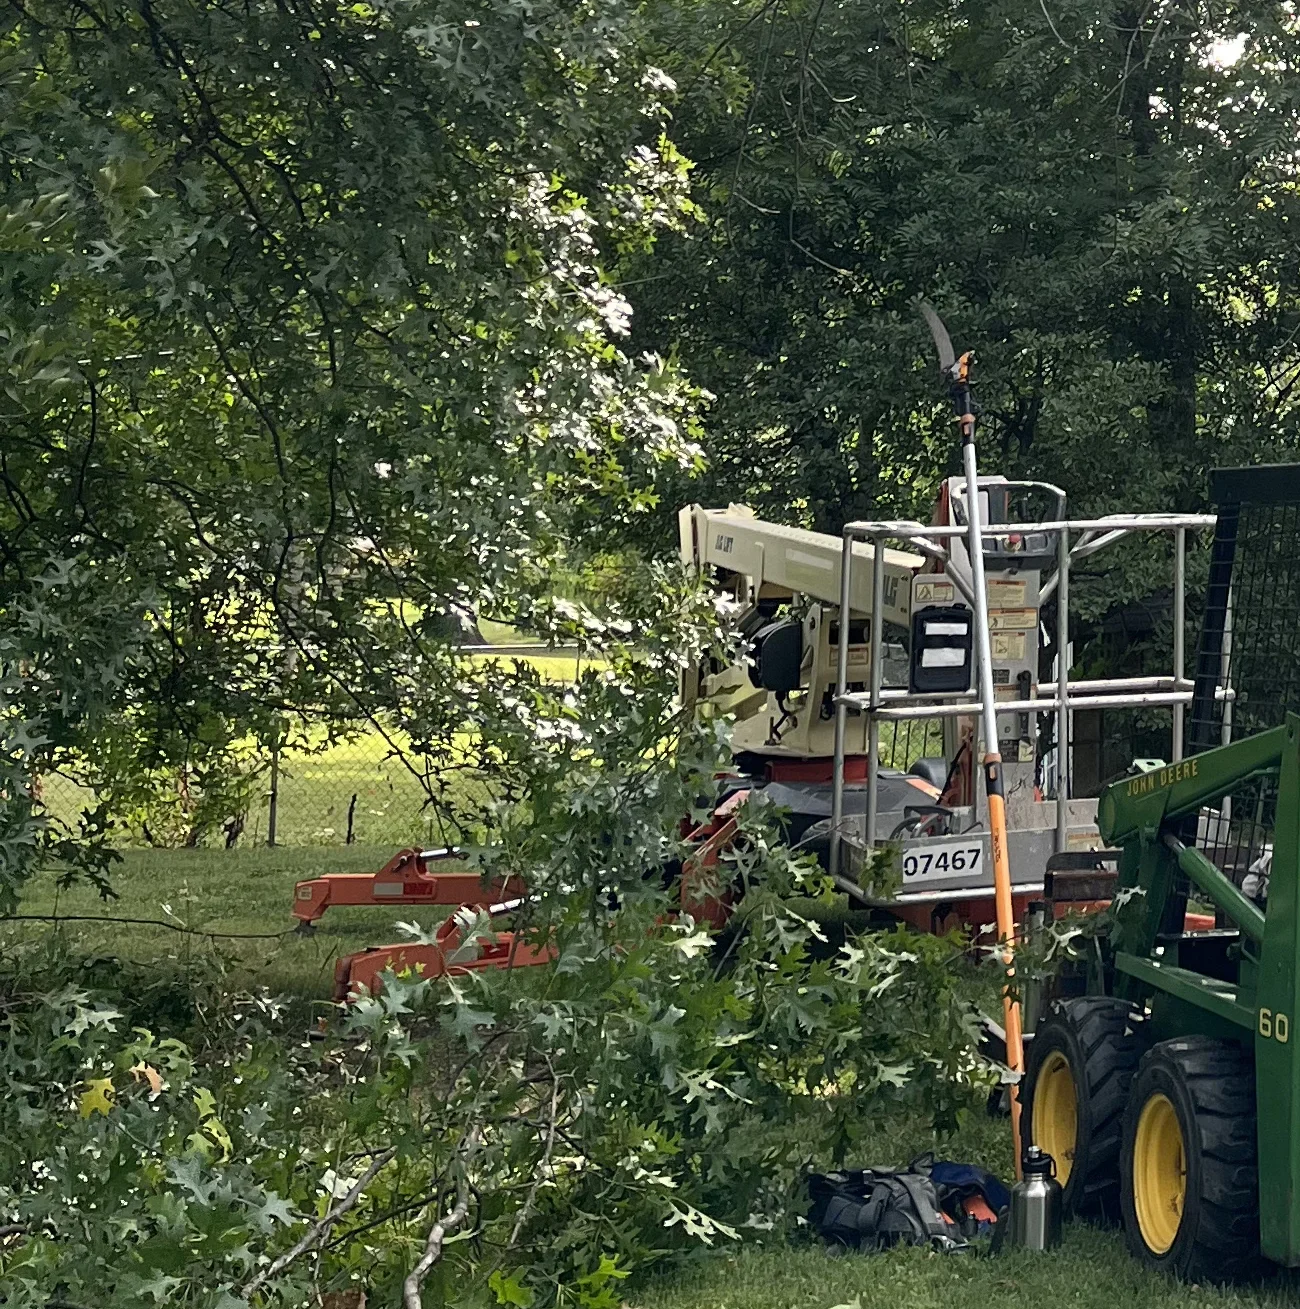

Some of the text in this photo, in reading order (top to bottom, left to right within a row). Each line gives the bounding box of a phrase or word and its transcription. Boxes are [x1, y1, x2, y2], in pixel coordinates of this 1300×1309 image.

[1127, 760, 1198, 797] JOHN DEERE
[903, 848, 981, 877] 07467
[1259, 1007, 1289, 1043] 60
